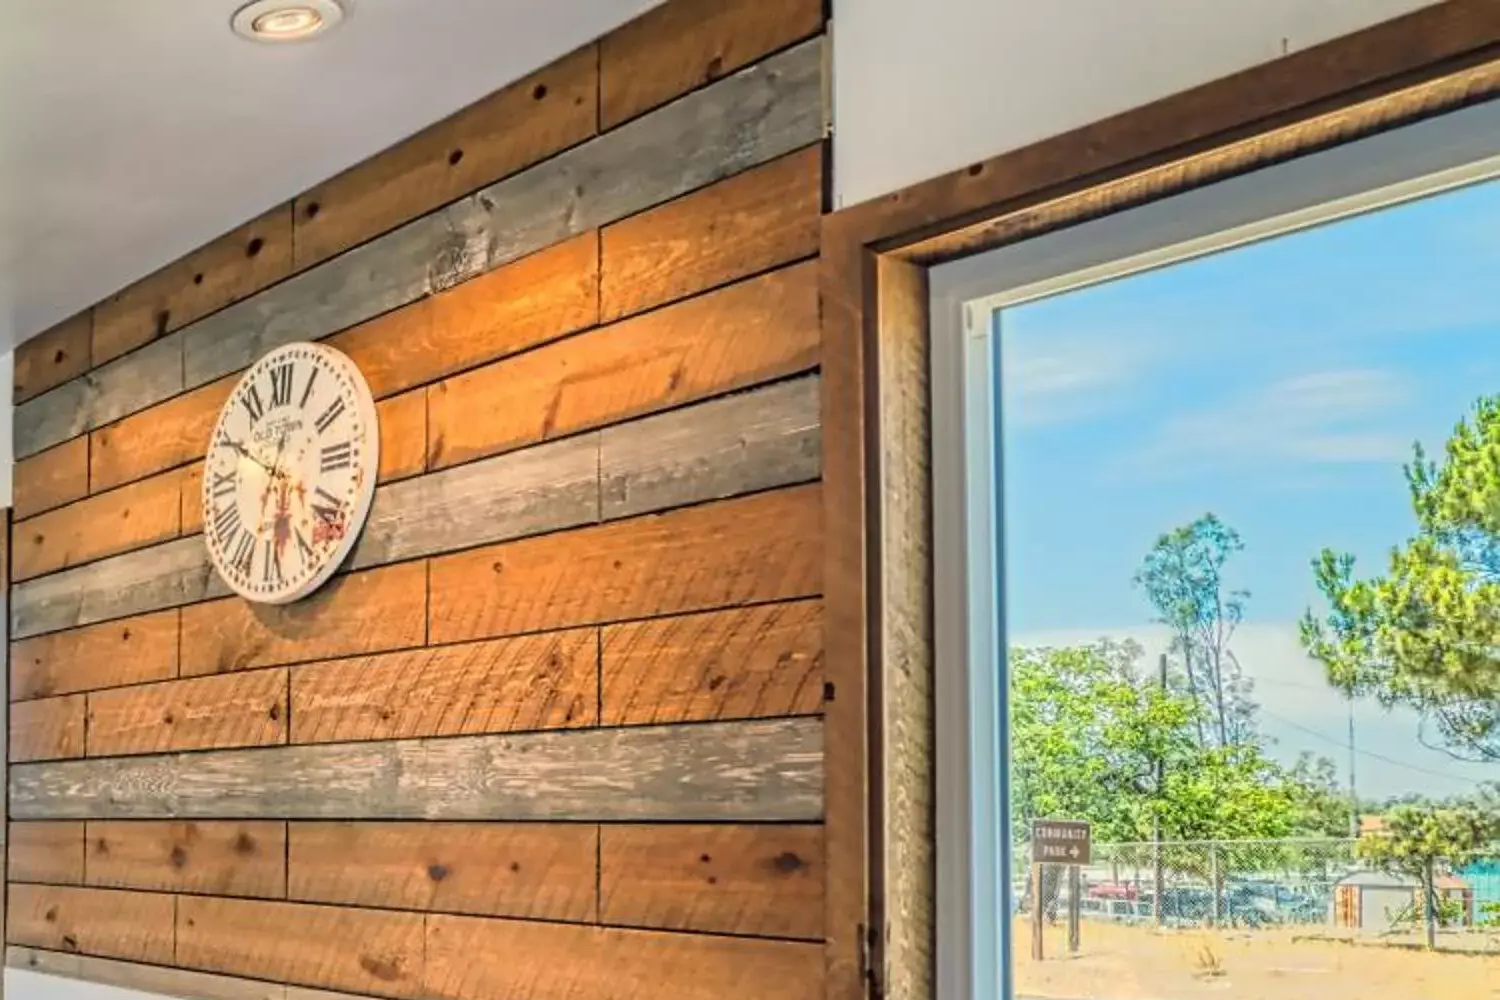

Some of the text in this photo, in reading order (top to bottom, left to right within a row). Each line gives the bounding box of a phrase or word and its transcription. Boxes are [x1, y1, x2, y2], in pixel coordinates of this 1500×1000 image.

[299, 365, 319, 409] I
[314, 396, 346, 434] II
[320, 441, 350, 472] III
